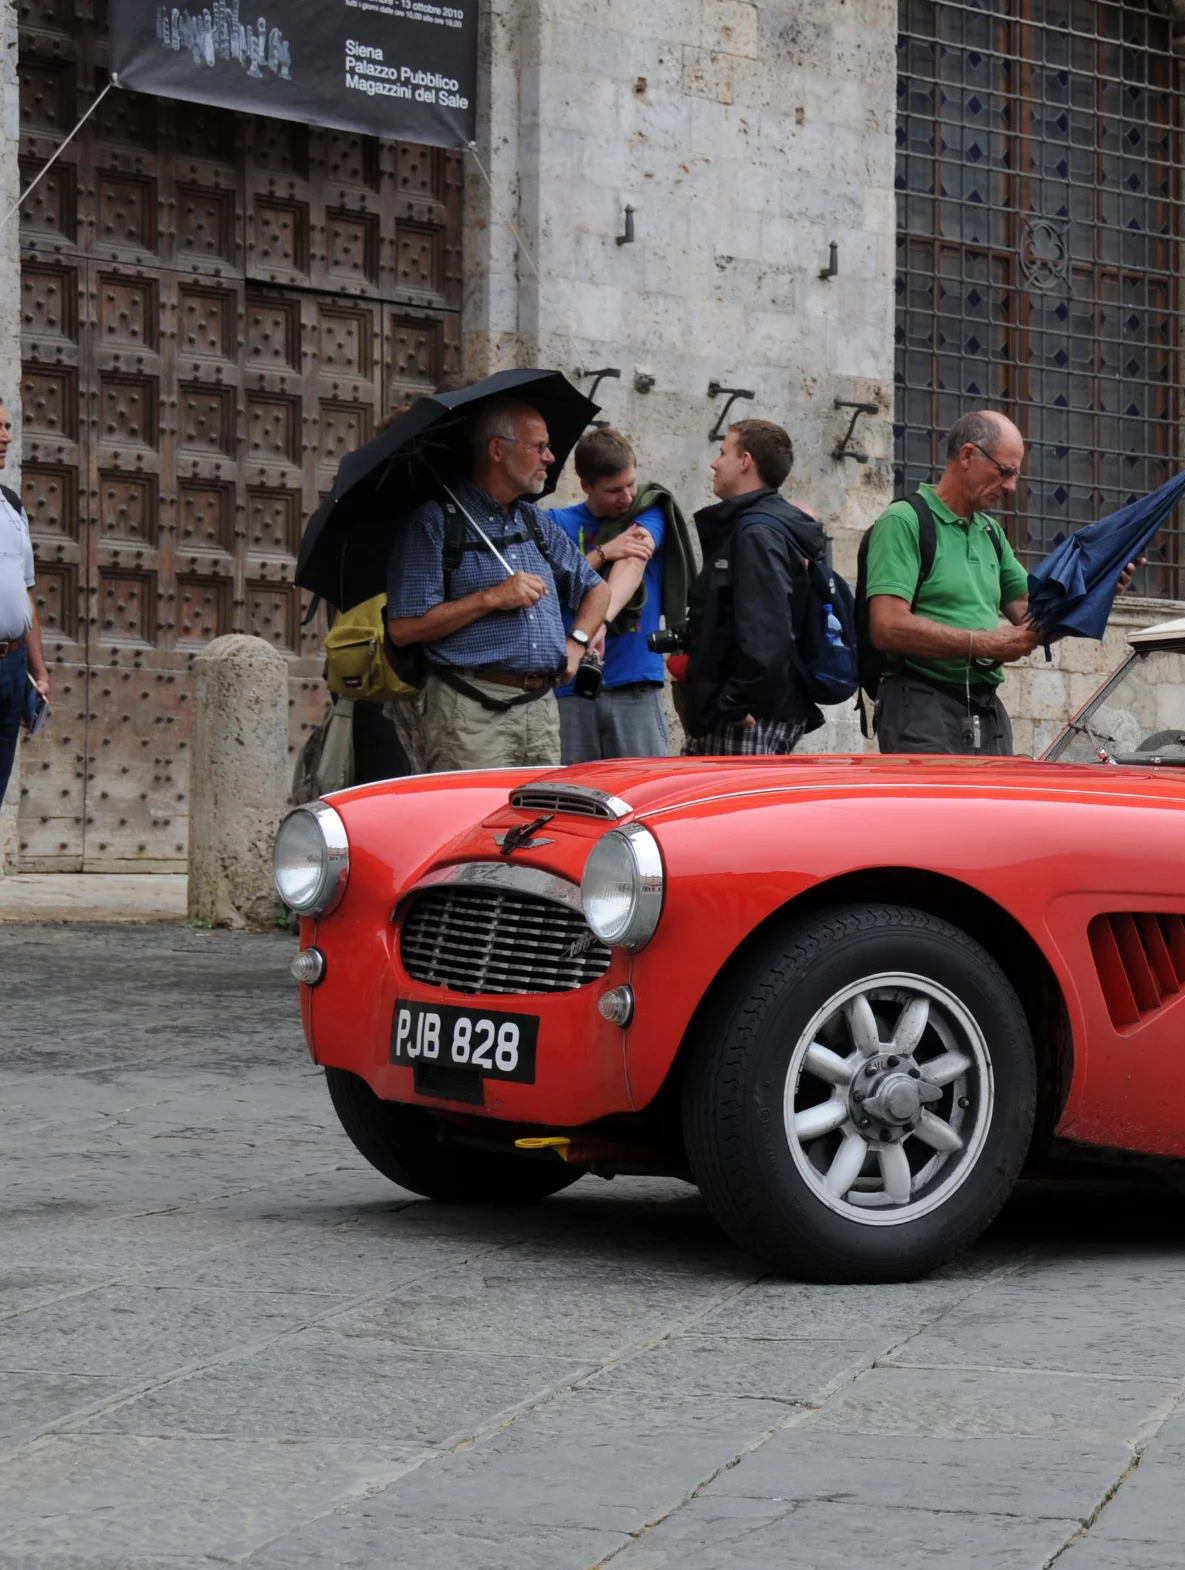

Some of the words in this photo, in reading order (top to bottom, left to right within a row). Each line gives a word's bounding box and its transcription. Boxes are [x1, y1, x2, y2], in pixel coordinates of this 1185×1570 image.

[361, 3, 379, 11] giorni
[380, 6, 394, 15] dalle
[394, 9, 405, 17] ore
[434, 17, 445, 25] ore
[412, 2, 442, 16] ottobre
[442, 7, 464, 19] 2010
[345, 39, 383, 60] Siena
[345, 56, 398, 80] Palazzo
[400, 67, 459, 91] Pubblico
[345, 73, 412, 99] Magazzini
[415, 86, 436, 103] del
[438, 91, 469, 109] Sale
[396, 1009, 441, 1059] PJB
[451, 1017, 520, 1072] 828
